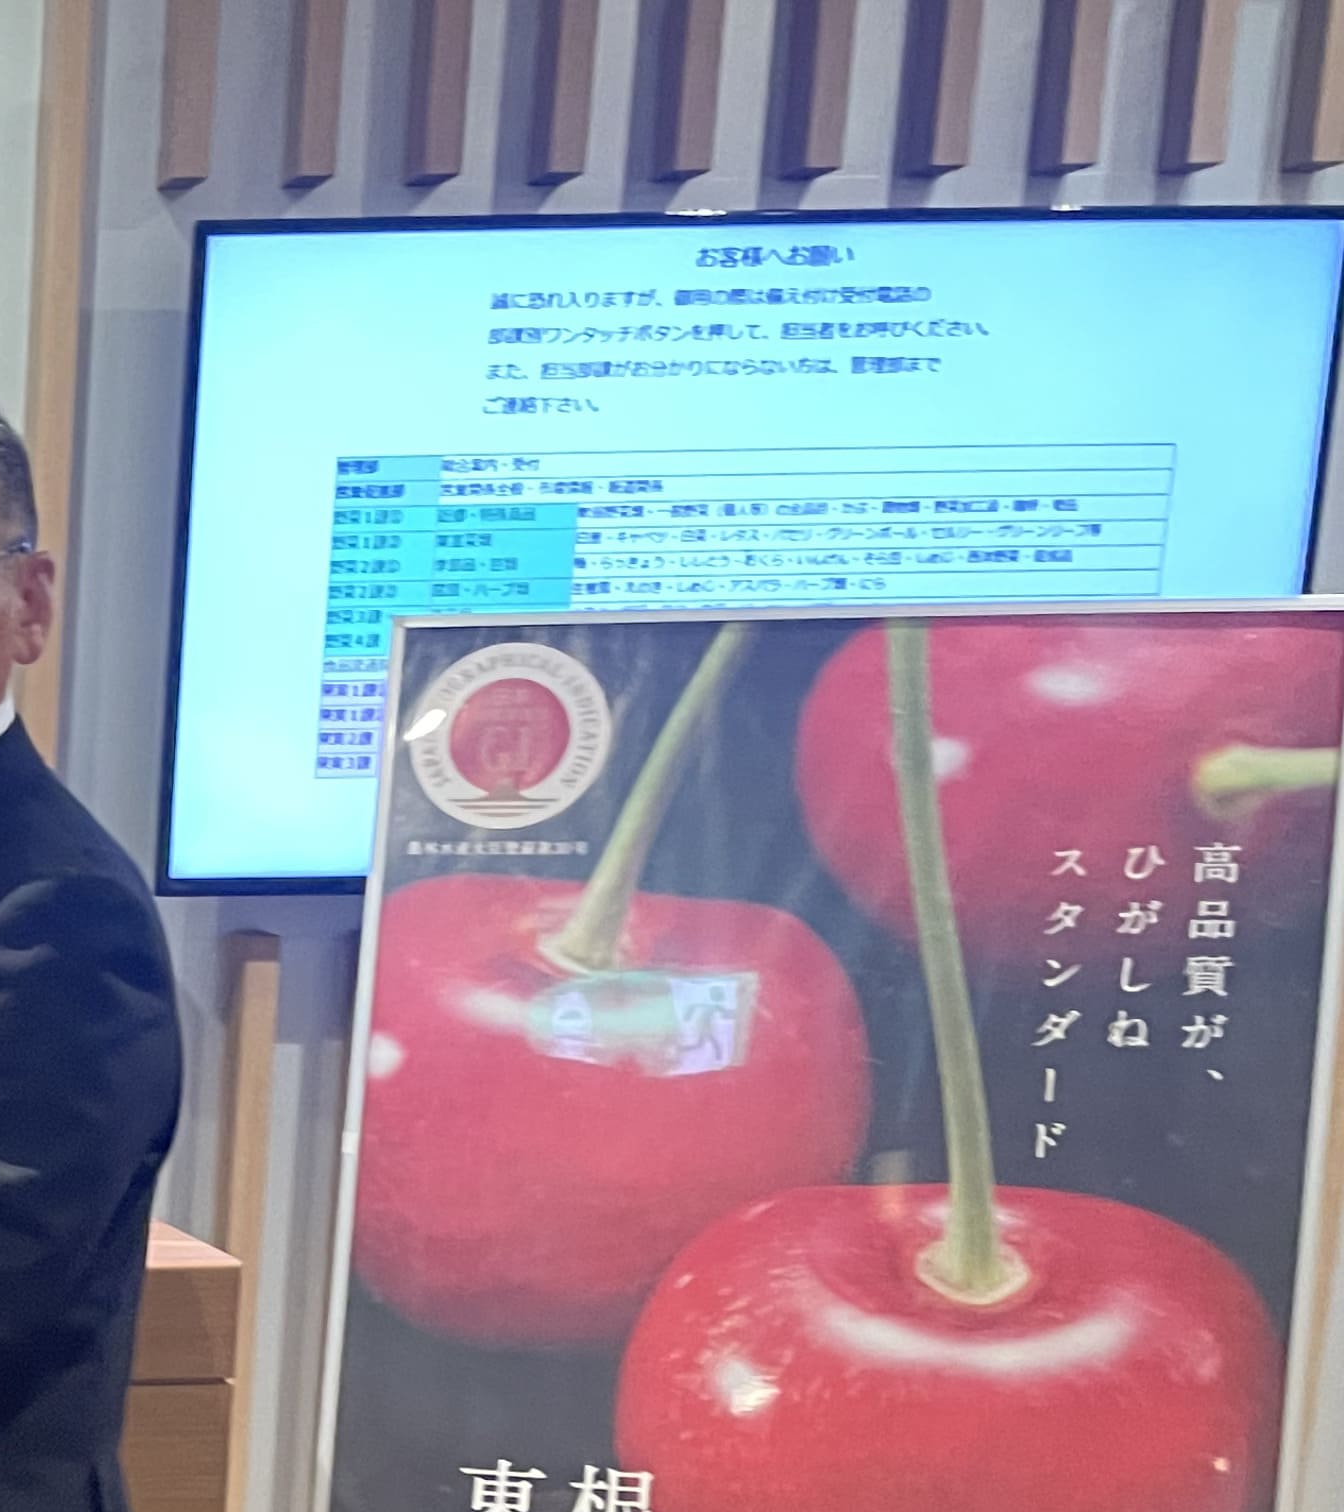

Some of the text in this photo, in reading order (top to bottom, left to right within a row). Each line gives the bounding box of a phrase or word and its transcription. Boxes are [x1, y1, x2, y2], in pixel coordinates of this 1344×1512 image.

[695, 245, 855, 268] お客様へお願い
[1029, 848, 1088, 1159] スタンダード
[1106, 844, 1167, 1048] ひがしね
[1180, 841, 1243, 1081] 高品質が、
